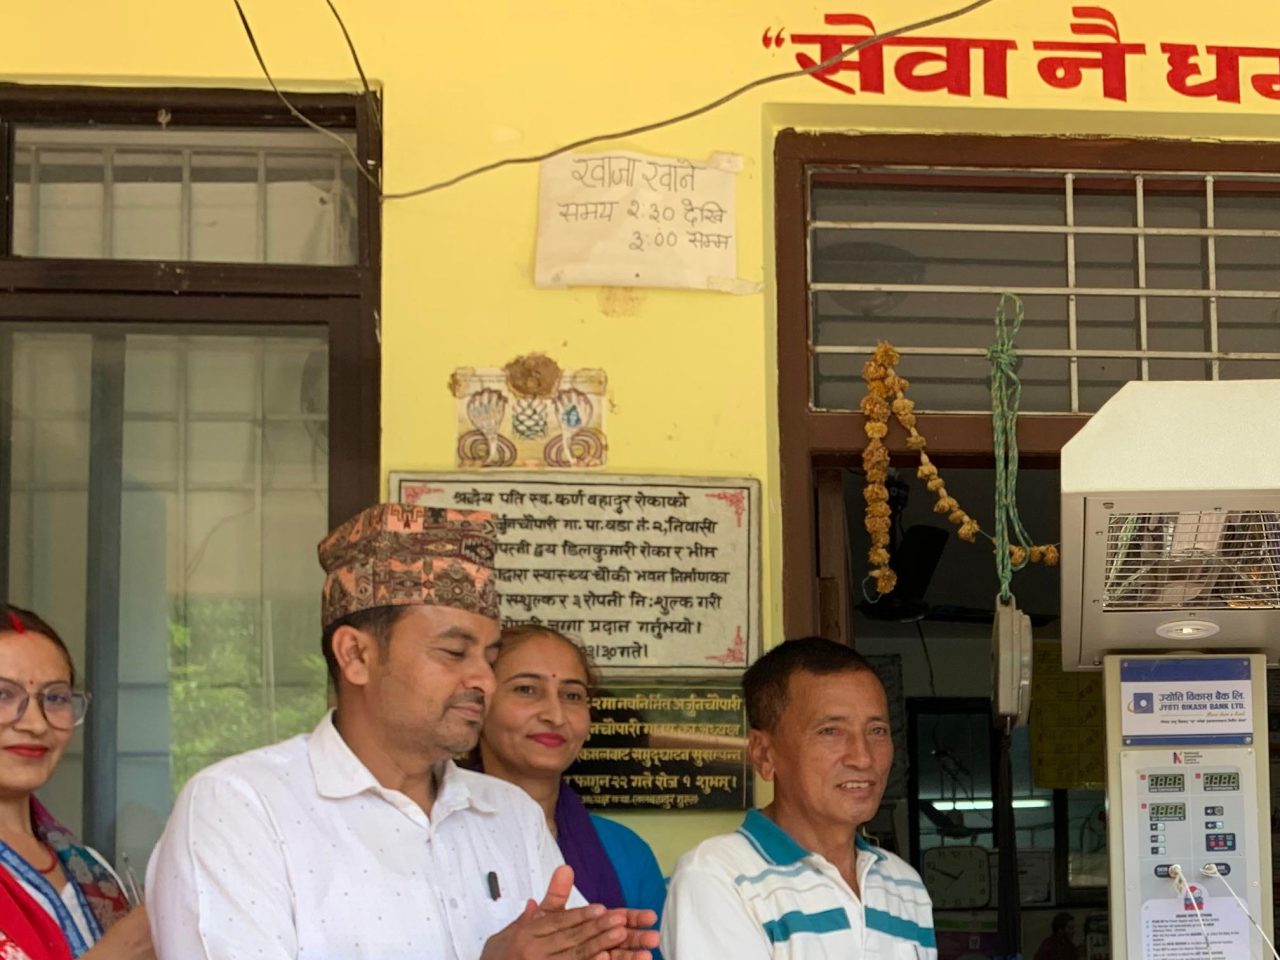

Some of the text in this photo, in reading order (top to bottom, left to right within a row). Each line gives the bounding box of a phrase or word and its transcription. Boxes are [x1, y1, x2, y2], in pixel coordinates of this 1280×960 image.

[1033, 6, 1147, 102] नै
[571, 156, 706, 192] खाजा खाने
[558, 201, 619, 222] समय
[499, 488, 524, 506] पति
[555, 488, 585, 507] कर्ण
[634, 491, 690, 509] रोकाको
[688, 541, 718, 559] भीम
[584, 591, 624, 609] रोपनी
[697, 592, 723, 610] गरी
[1186, 690, 1213, 701] विकास
[1159, 703, 1179, 711] JYOTI
[1181, 703, 1207, 711] BIKASH
[611, 777, 628, 789] २२
